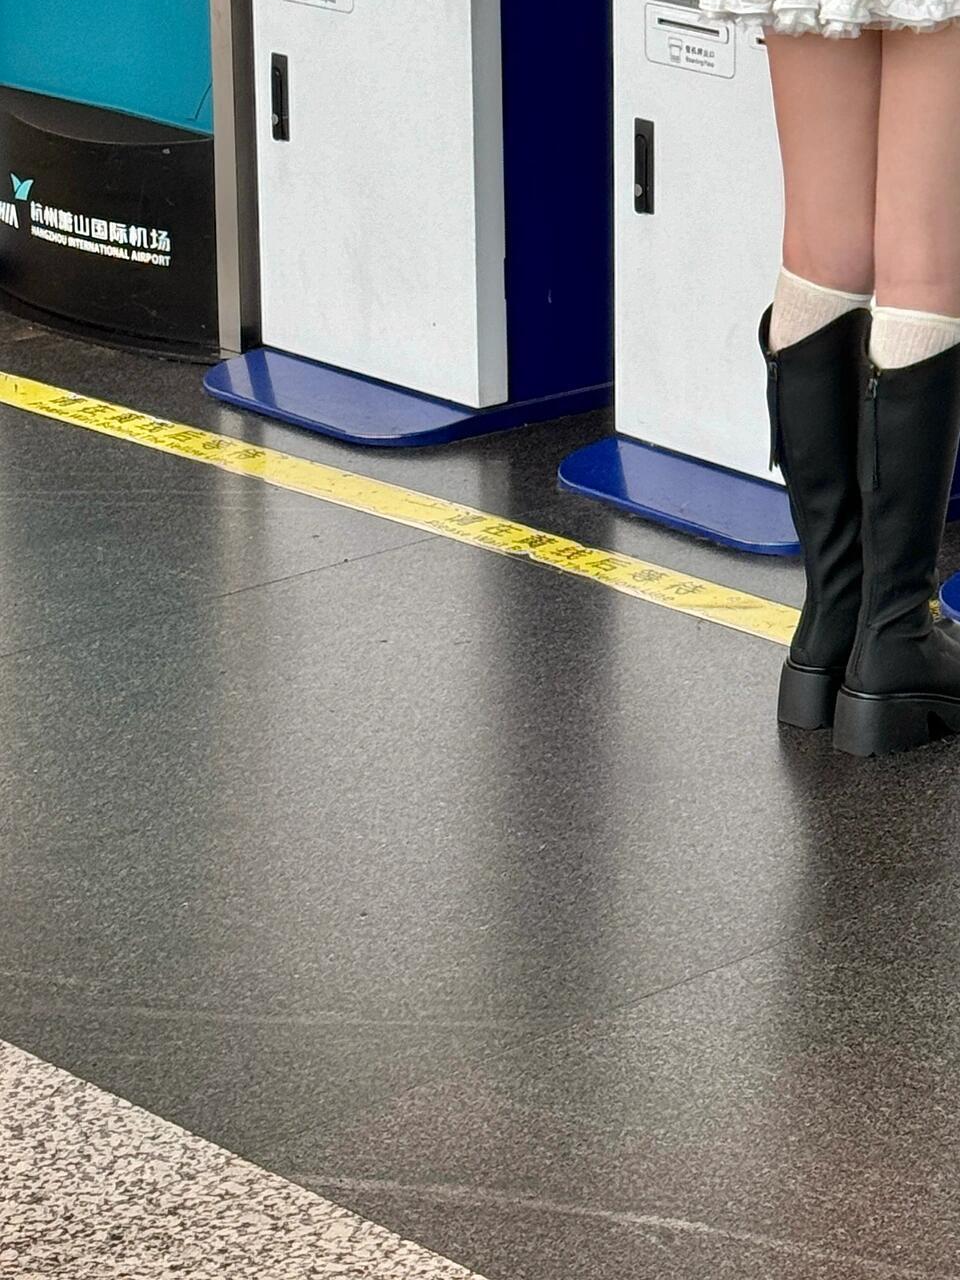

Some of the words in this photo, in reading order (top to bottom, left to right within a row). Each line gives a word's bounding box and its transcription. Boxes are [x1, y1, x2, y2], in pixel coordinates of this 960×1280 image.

[30, 200, 172, 253] 杭州萧山国际机场
[30, 224, 68, 246] HANGZHOU
[67, 234, 131, 261] INTERNATIONAL
[130, 249, 172, 267] AIRPORT
